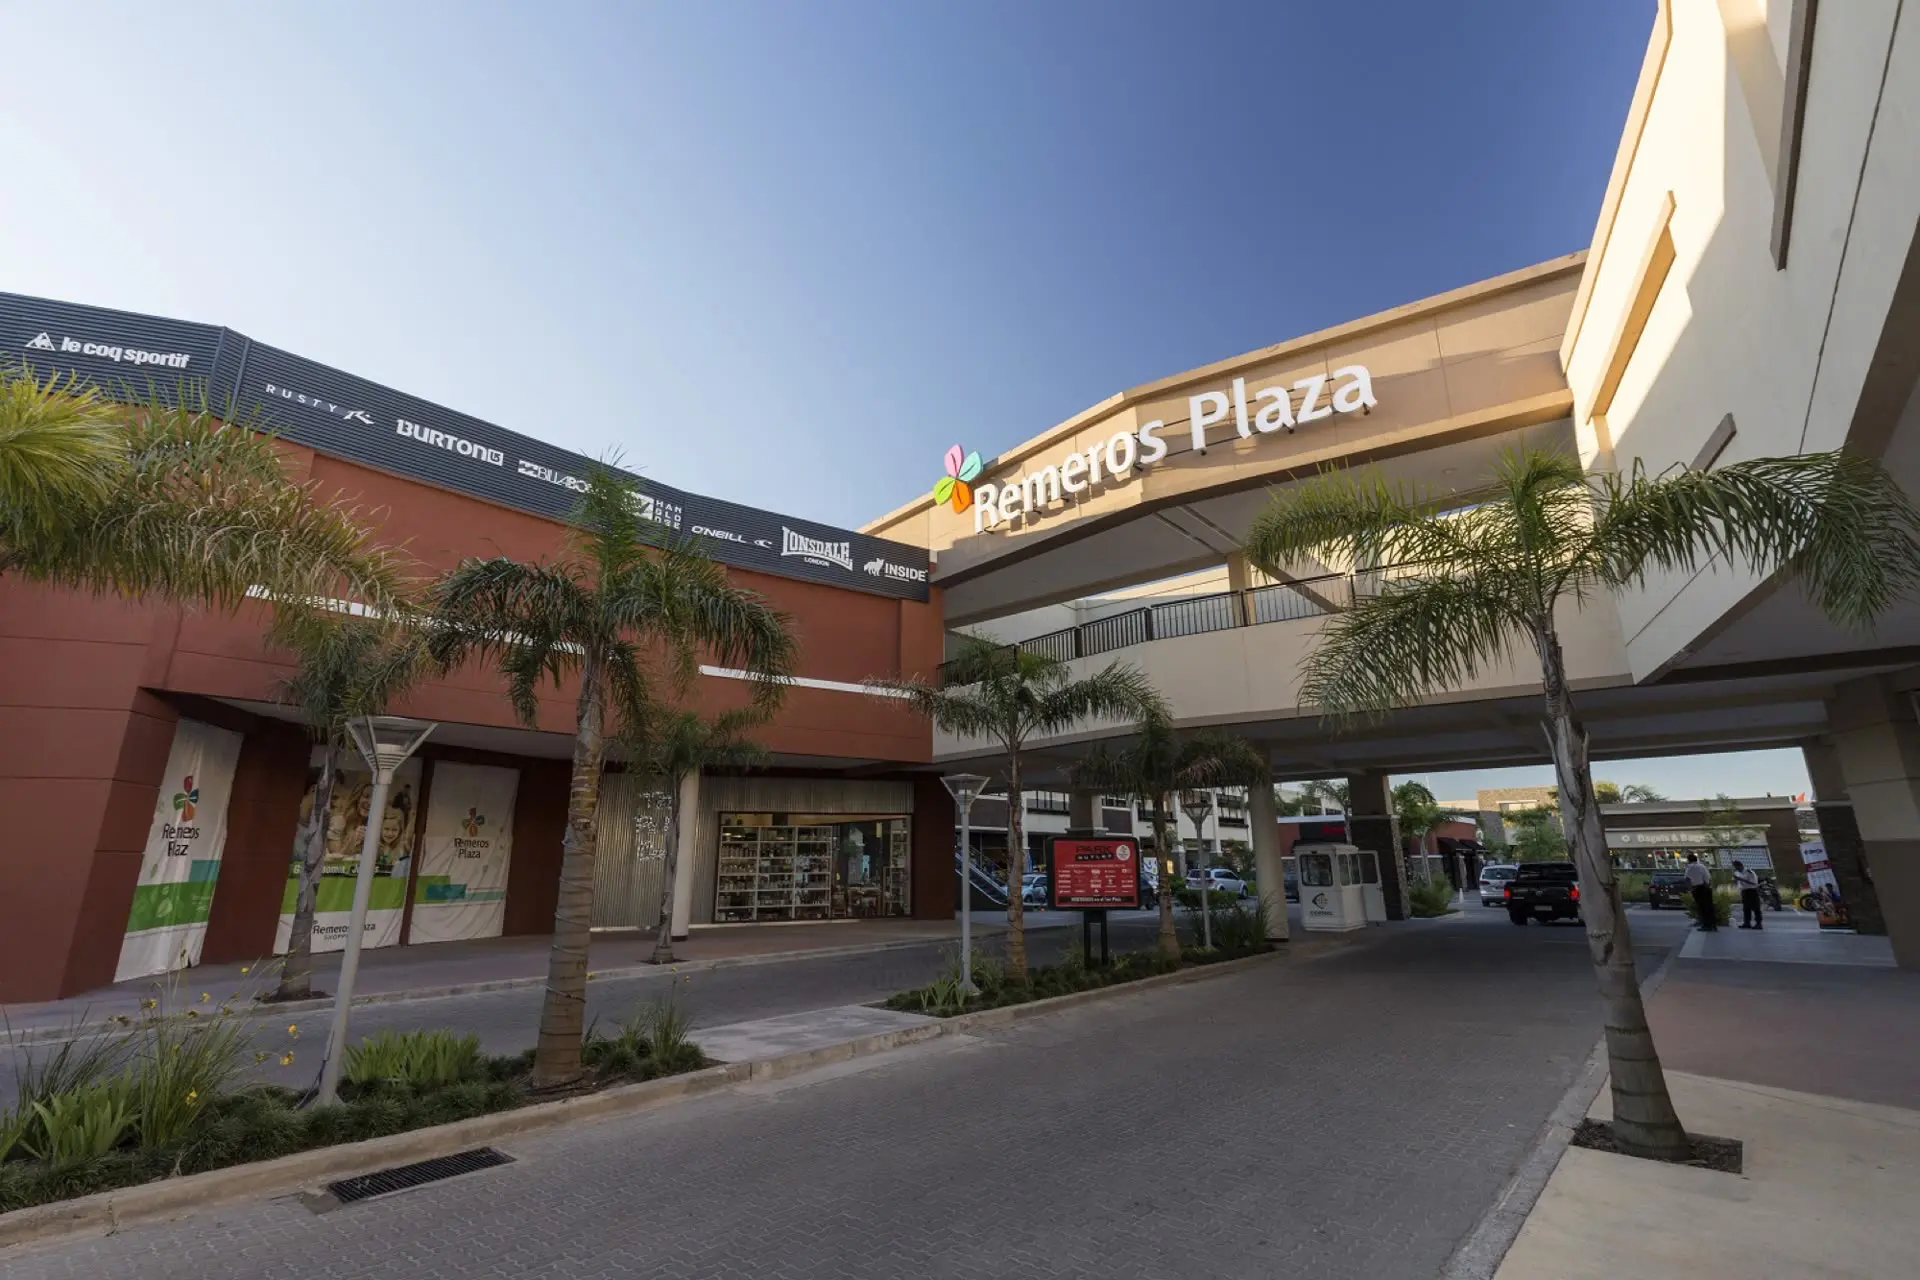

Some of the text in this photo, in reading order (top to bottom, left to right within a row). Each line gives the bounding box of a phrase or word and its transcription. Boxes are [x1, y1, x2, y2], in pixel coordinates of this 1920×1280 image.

[61, 336, 190, 369] le coq sportif
[265, 383, 338, 413] RUSTY
[395, 419, 487, 462] BURTON
[973, 363, 1378, 535] Remeros Plaza
[537, 467, 601, 497] BILLABO
[656, 500, 682, 514] HAN
[781, 525, 853, 567] LONSDALE
[804, 556, 830, 567] LONDON
[884, 562, 926, 582] INSIDE
[167, 840, 189, 857] Plaz
[454, 837, 489, 848] Remeros
[458, 848, 481, 859] Plaza
[312, 925, 350, 934] Remero
